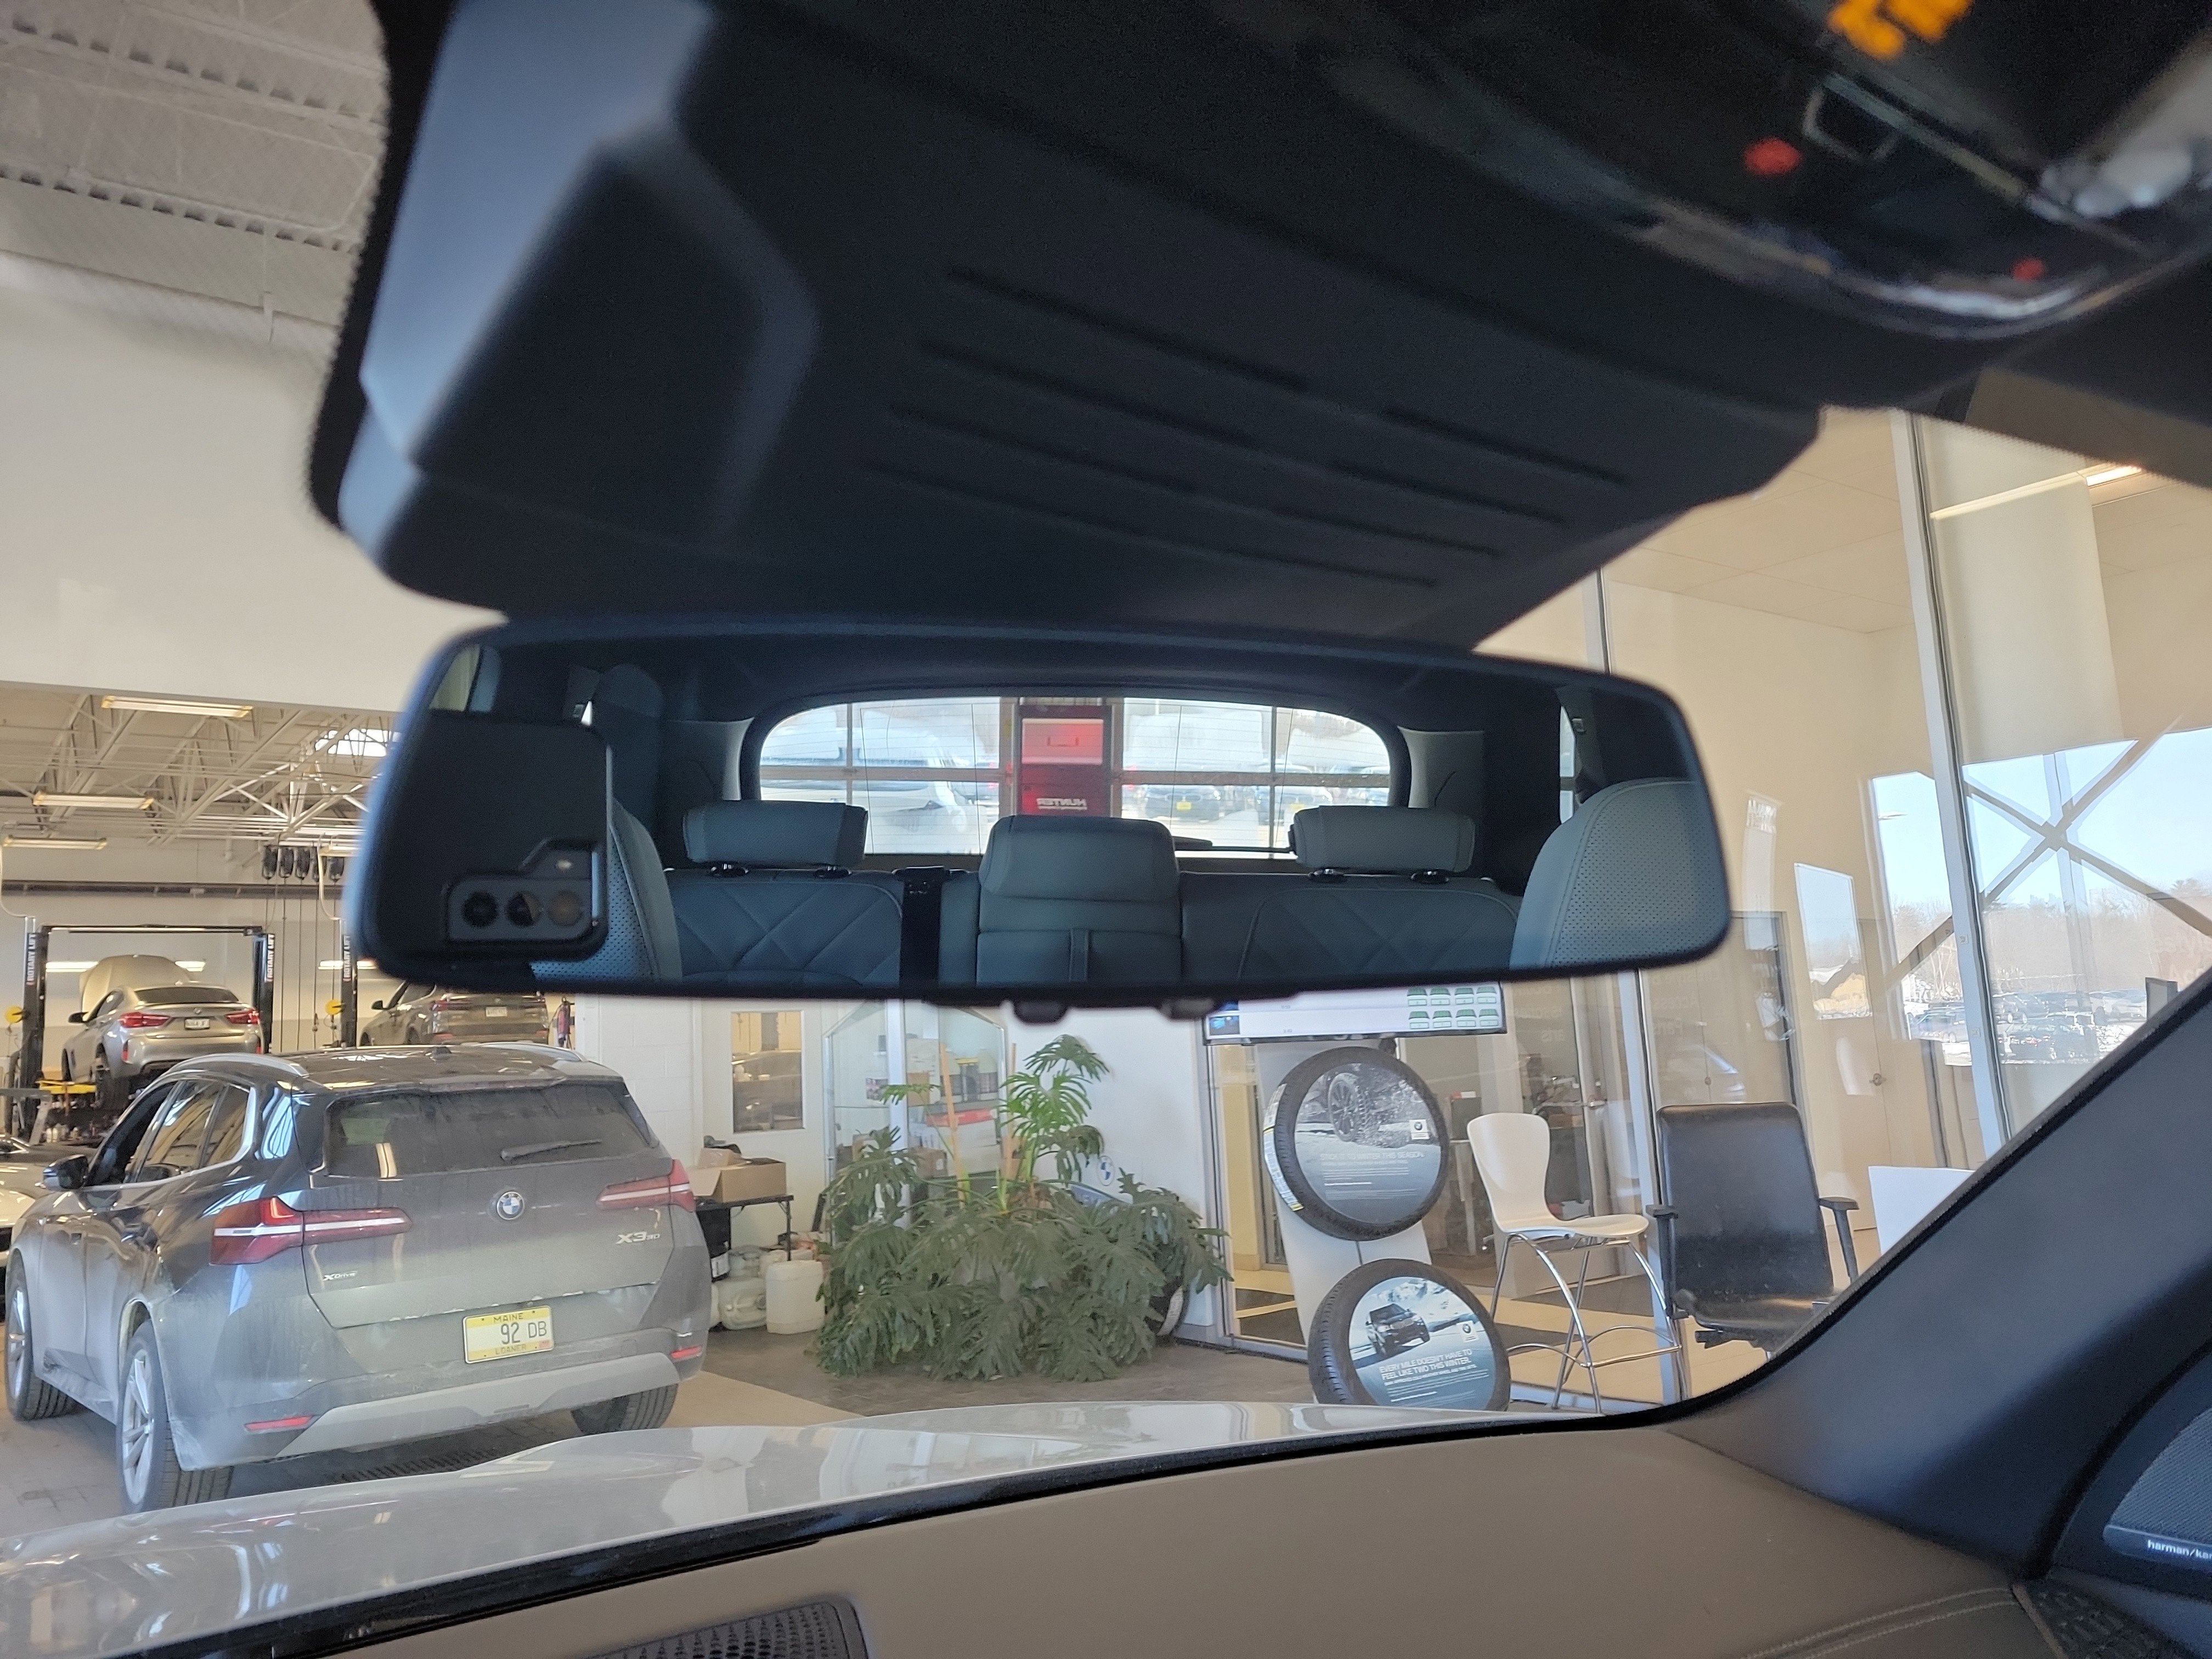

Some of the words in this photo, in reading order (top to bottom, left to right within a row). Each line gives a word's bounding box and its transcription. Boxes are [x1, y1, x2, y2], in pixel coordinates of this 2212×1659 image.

[27, 950, 35, 981] ROTARY
[615, 1232, 647, 1244] X3
[493, 1313, 524, 1323] MAINE
[500, 1322, 521, 1345] 92
[528, 1321, 547, 1338] DB
[495, 1344, 527, 1355] LOANER
[1379, 1363, 1401, 1373] EVERY
[1401, 1360, 1417, 1369] MILE
[1444, 1350, 1463, 1360] HAVE
[1381, 1371, 1399, 1380] FEEL
[1398, 1368, 1414, 1377] LIKE
[1413, 1365, 1429, 1374] TWO
[1428, 1361, 1445, 1370] THIS
